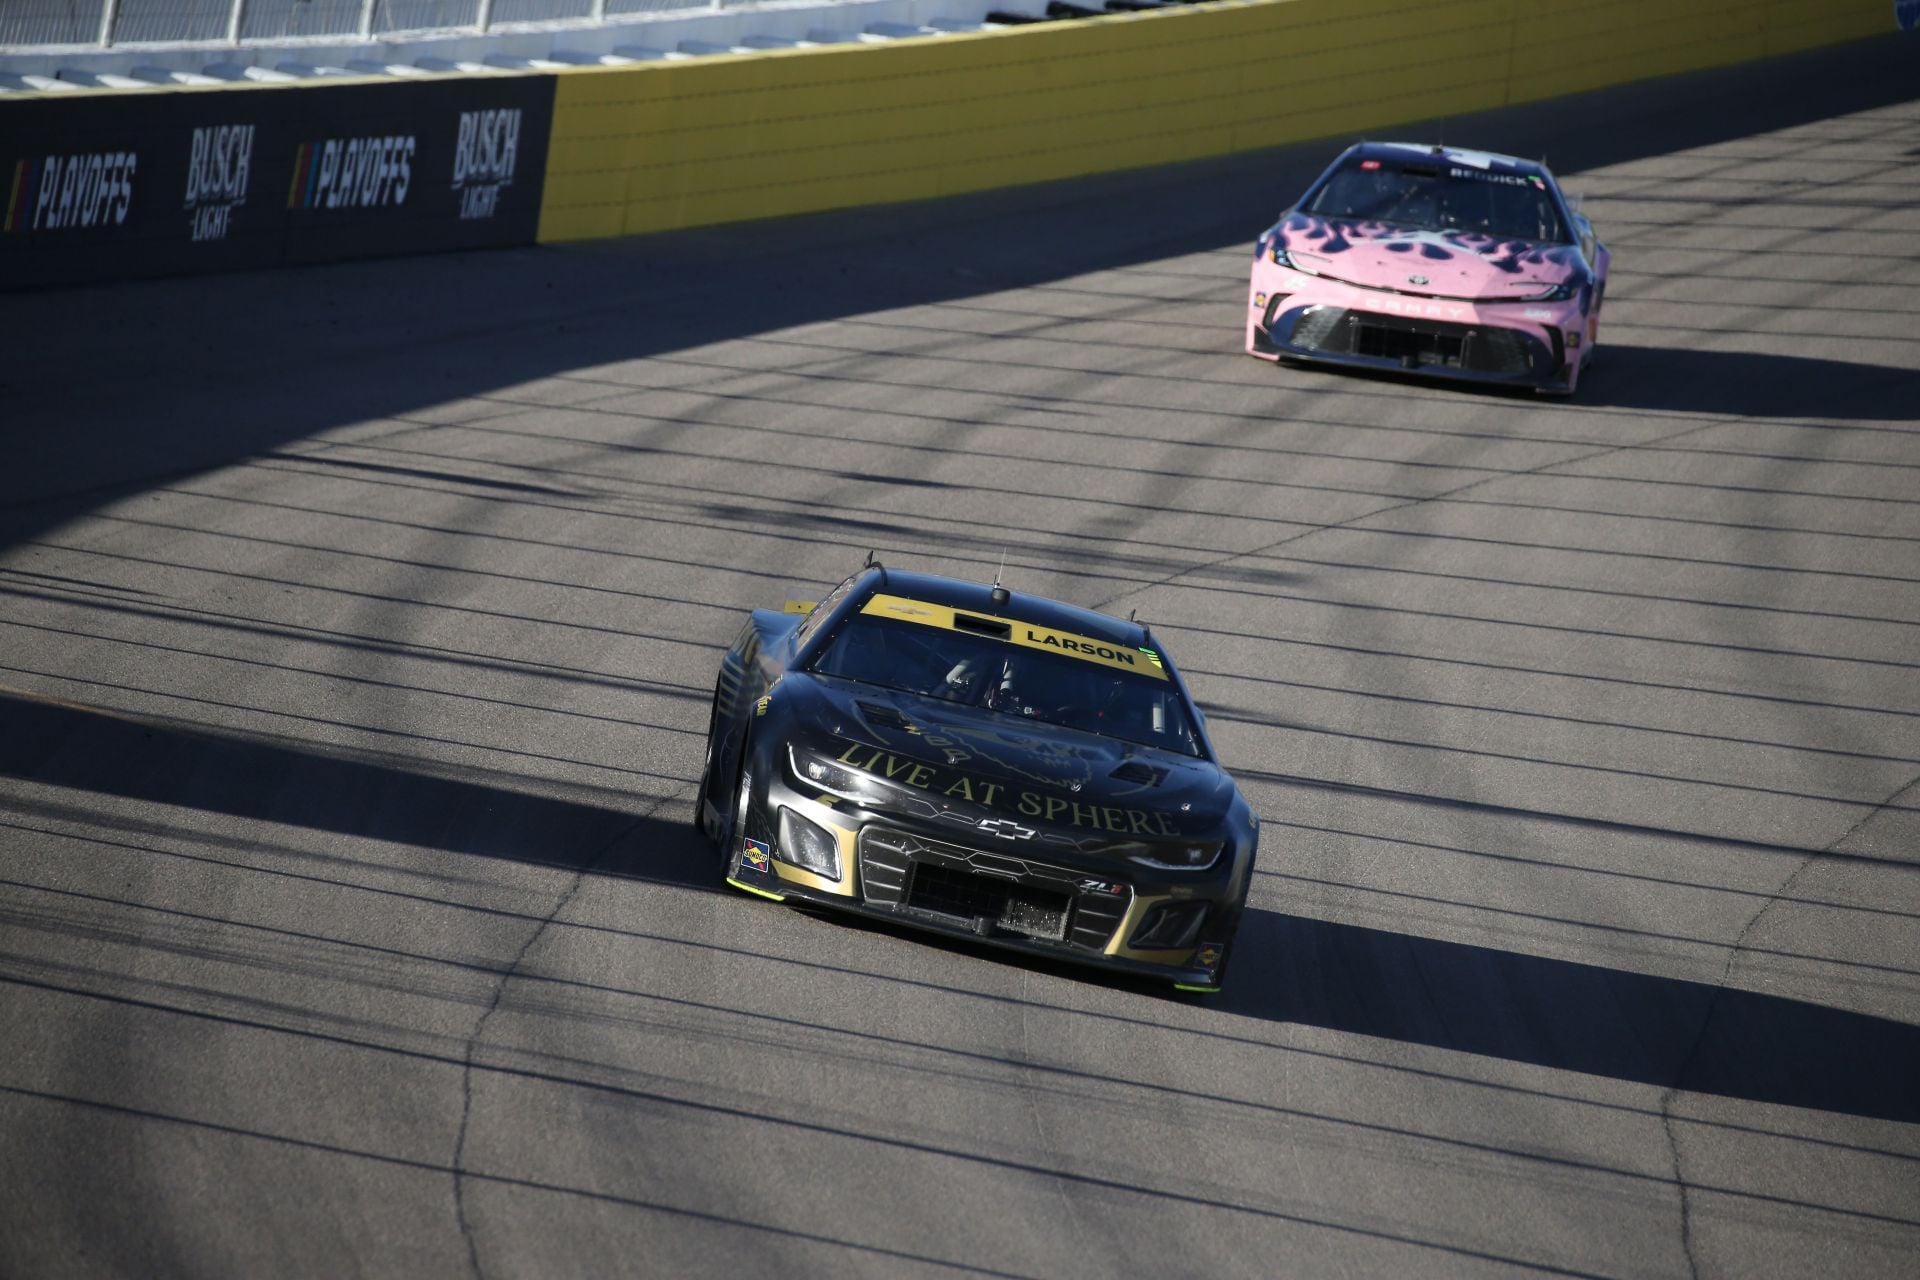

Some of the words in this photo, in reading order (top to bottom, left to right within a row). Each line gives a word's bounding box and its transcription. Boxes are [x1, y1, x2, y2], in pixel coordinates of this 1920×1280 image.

[185, 124, 255, 200] BUSCH
[314, 135, 416, 208] PLAYOFFS
[453, 107, 522, 181] BUSCH
[33, 151, 137, 229] PLAYOFFS
[460, 184, 499, 219] LIGHT
[191, 204, 231, 241] LIGHT
[1365, 297, 1464, 318] CAMRY
[1027, 630, 1135, 665] LARSON
[835, 742, 941, 790] LIVE
[944, 774, 1004, 806] AT
[1018, 791, 1181, 836] SPHERE
[744, 848, 768, 863] SUNOCO
